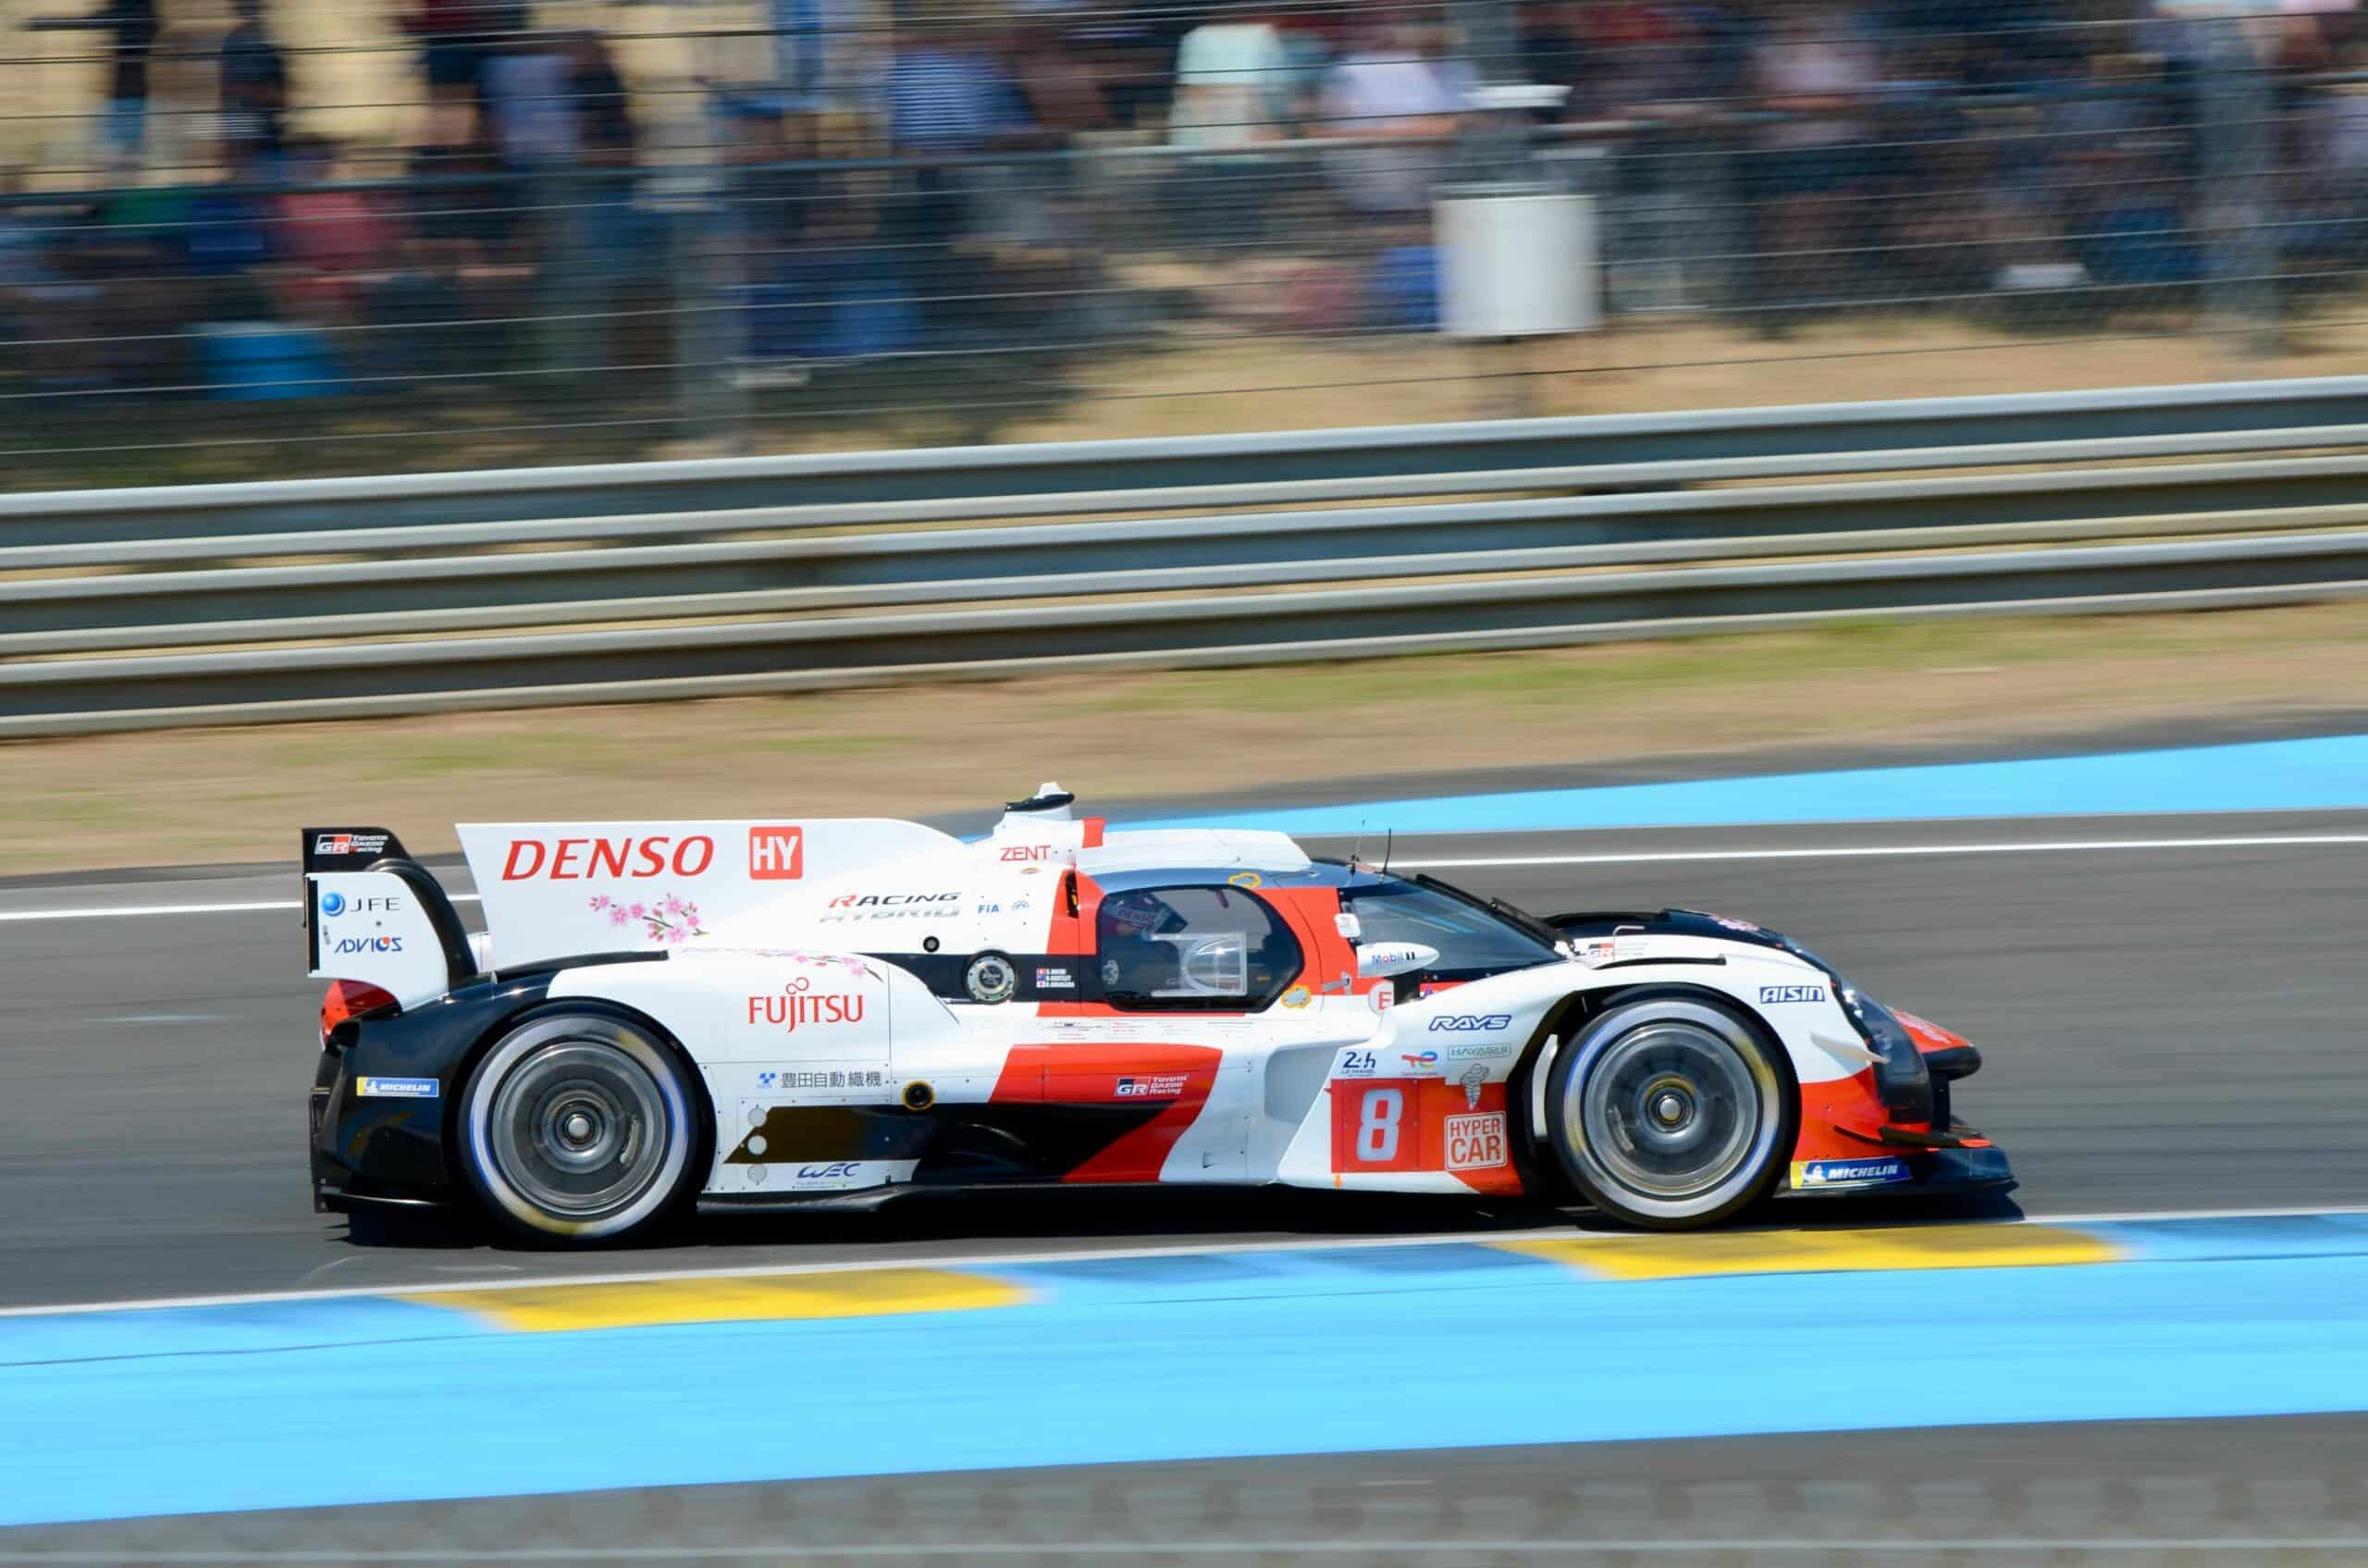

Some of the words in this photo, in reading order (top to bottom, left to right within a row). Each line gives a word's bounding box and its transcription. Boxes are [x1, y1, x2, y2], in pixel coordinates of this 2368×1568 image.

[318, 842, 350, 853] GR
[752, 835, 800, 871] HY
[999, 845, 1052, 861] ZENT
[501, 835, 714, 881] DENSO
[350, 897, 401, 912] JFE
[828, 892, 963, 909] RACING
[978, 904, 1000, 914] FIA
[334, 936, 402, 954] ADVICS
[1372, 953, 1404, 963] Mobil
[1760, 986, 1825, 1004] AISIN
[747, 993, 864, 1033] FUJITSU
[1429, 1015, 1511, 1031] RAYS
[1449, 1044, 1509, 1057] HAYASHI
[379, 1083, 431, 1092] MICHELIN
[1116, 1084, 1148, 1095] GR
[1356, 1088, 1403, 1161] 8
[1449, 1117, 1501, 1138] HYPER
[1450, 1135, 1501, 1163] CAR
[797, 1163, 861, 1178] WEC
[1828, 1165, 1898, 1179] MICHELIN
